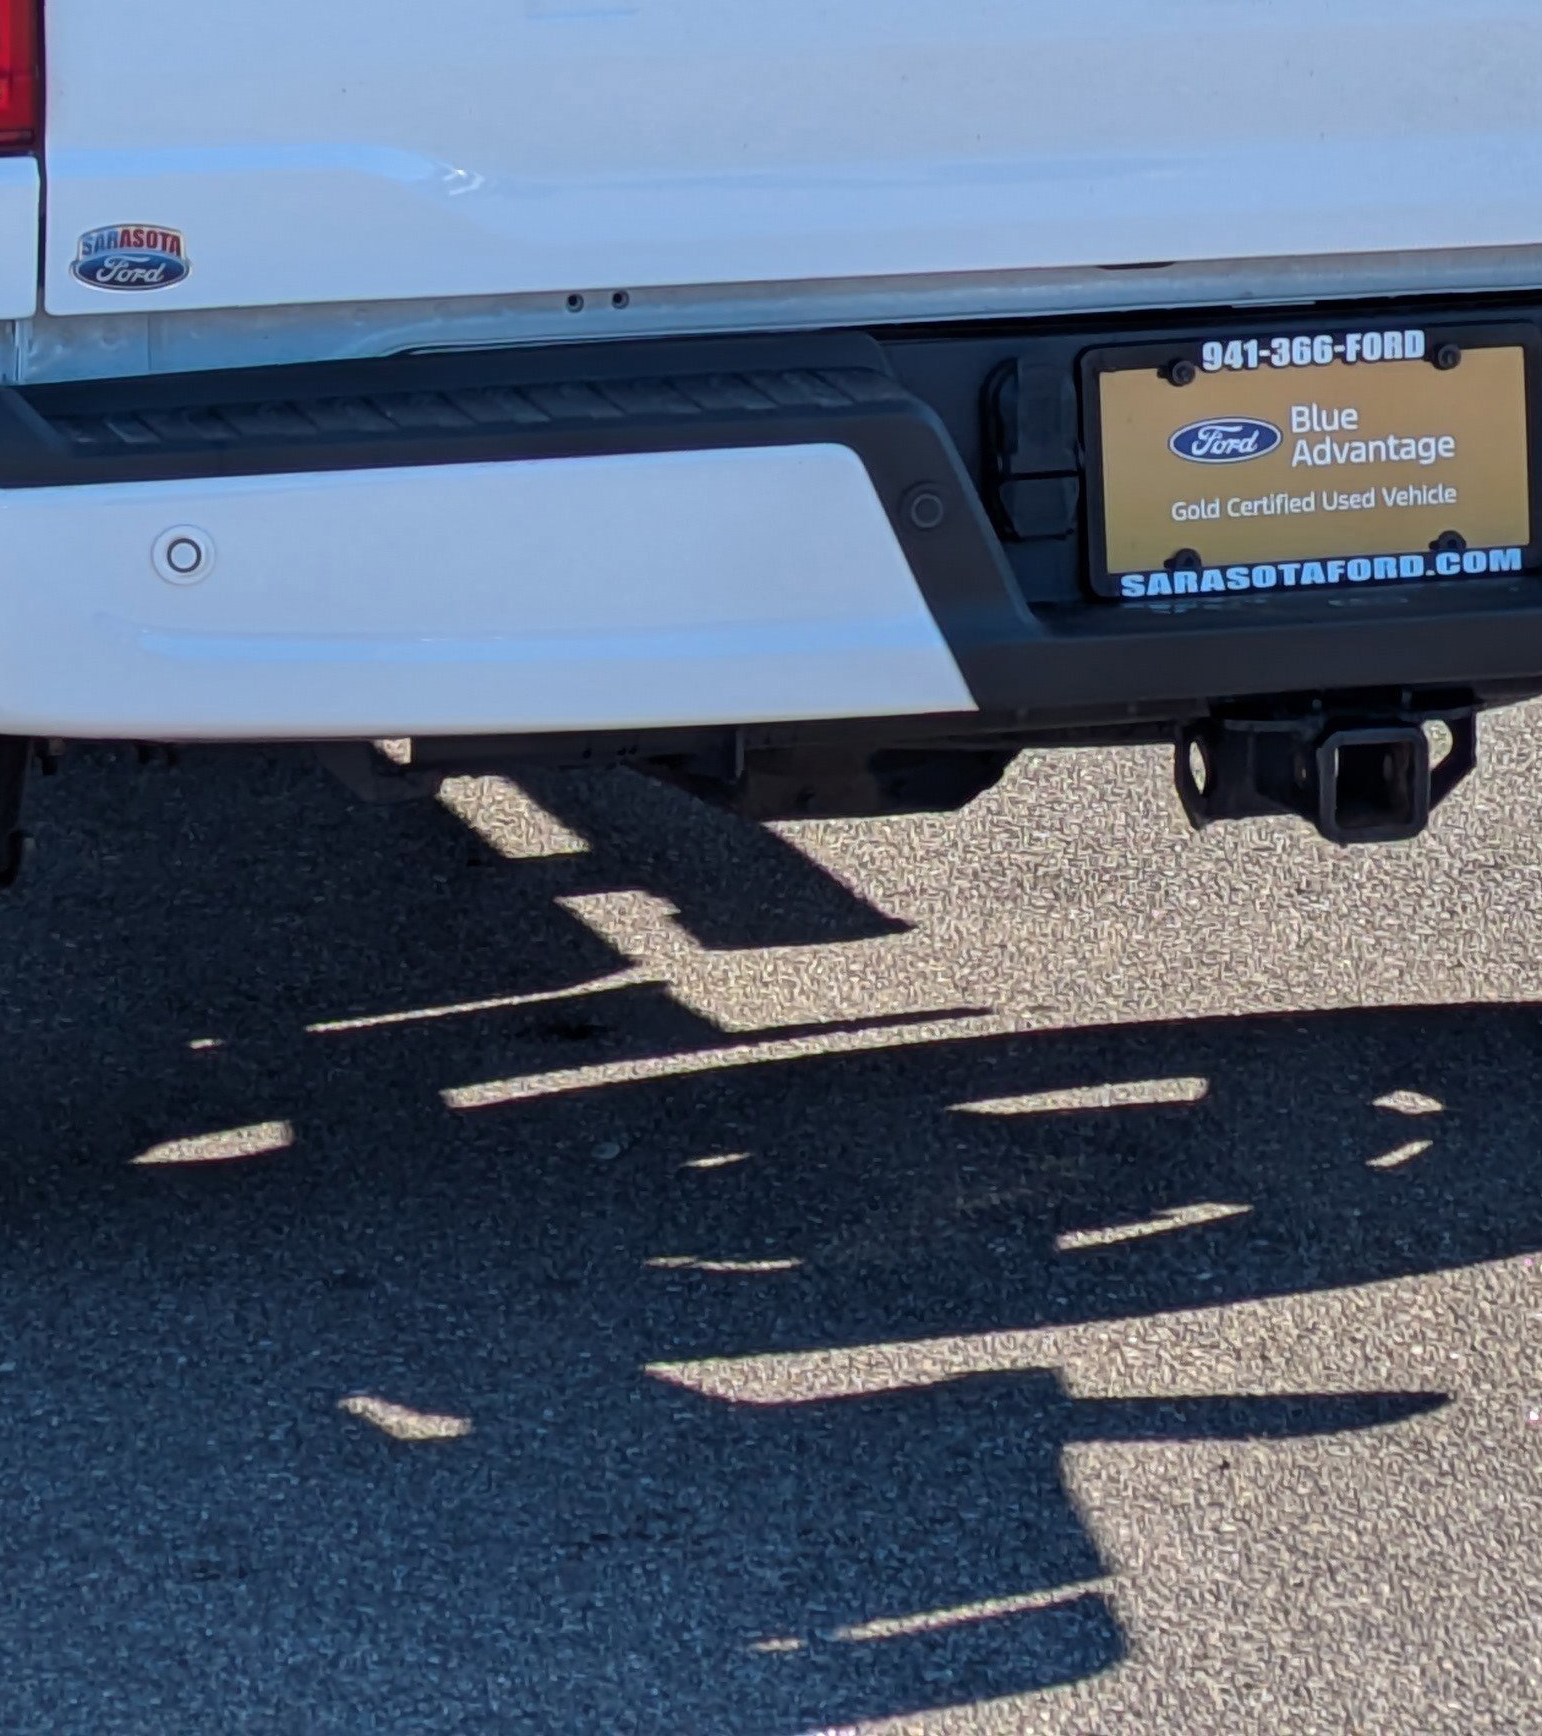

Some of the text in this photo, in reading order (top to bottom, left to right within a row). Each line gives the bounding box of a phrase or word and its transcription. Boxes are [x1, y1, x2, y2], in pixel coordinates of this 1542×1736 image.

[82, 228, 182, 257] SARASOTA
[96, 253, 166, 283] Ford
[1202, 330, 1425, 371] 941-366-FORD
[1291, 403, 1358, 433] Blue
[1191, 425, 1259, 456] Ford
[1291, 435, 1456, 467] Advantage
[1171, 483, 1457, 521] Gold Certified Used Vehicle
[1121, 548, 1522, 598] SARASOTAFORD.COM
